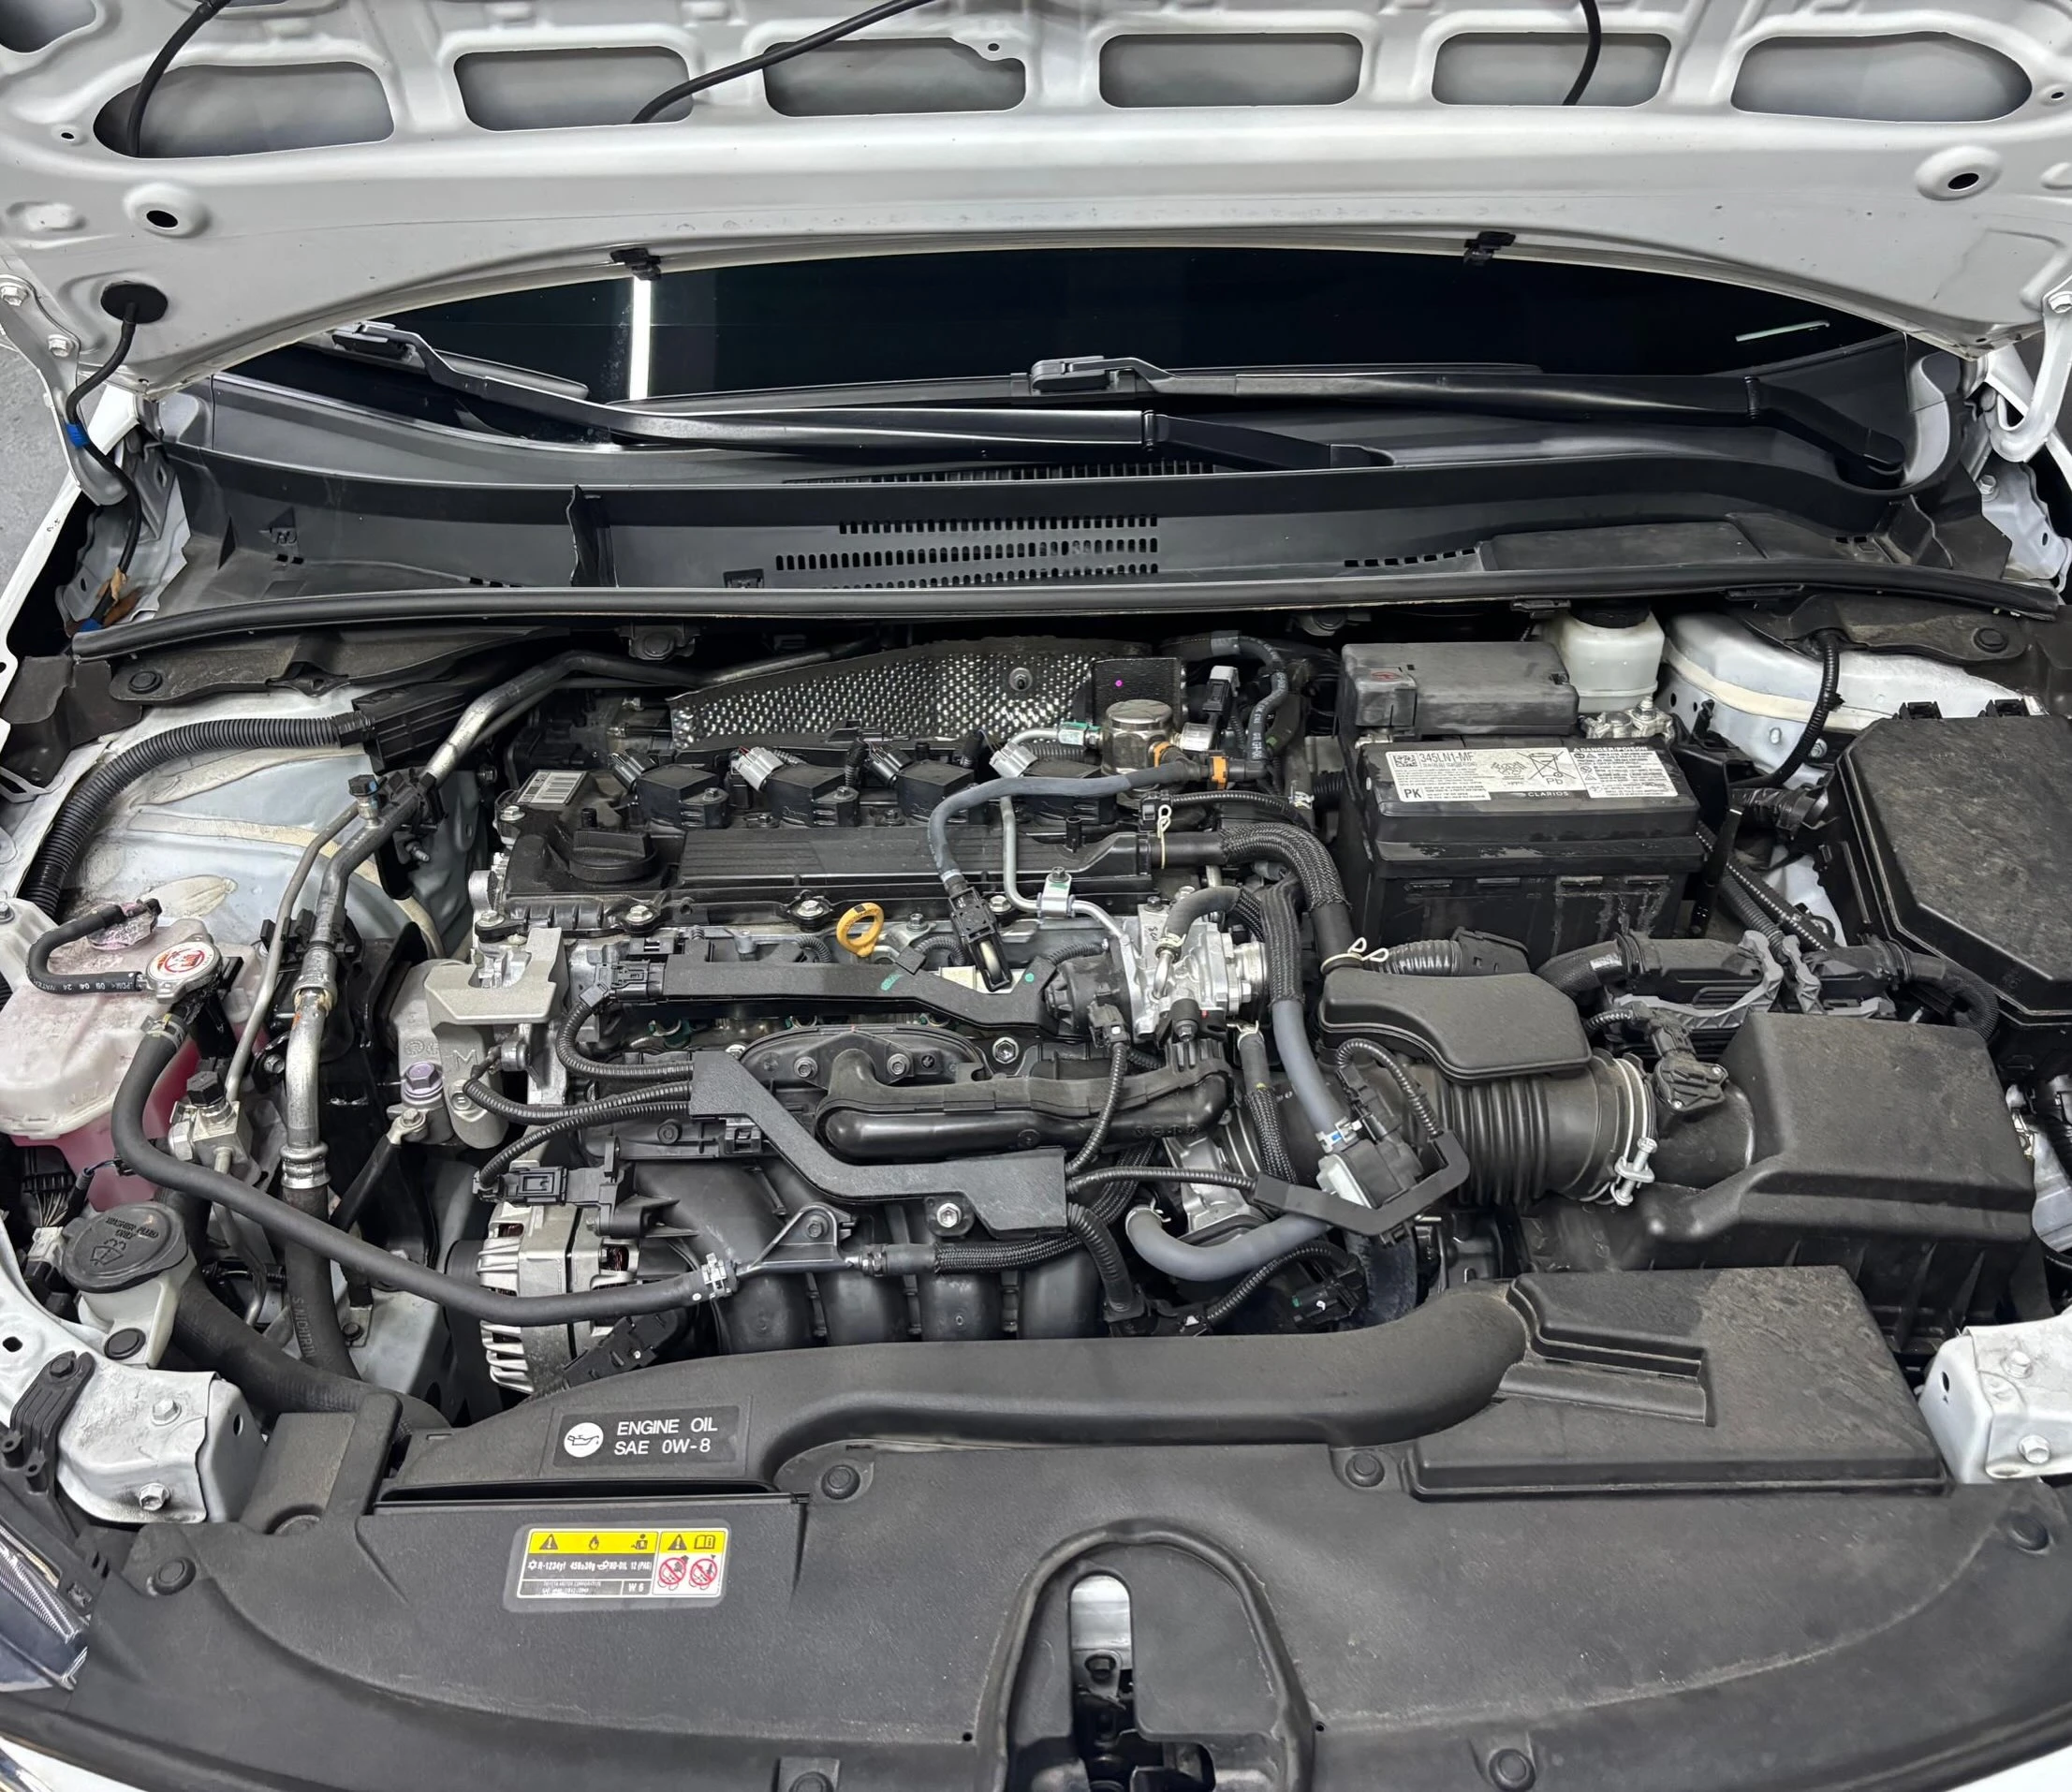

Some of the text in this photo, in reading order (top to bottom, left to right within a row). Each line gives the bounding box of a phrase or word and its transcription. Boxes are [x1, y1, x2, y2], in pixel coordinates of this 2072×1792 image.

[1419, 752, 1475, 763] 345LN1-MF
[1546, 777, 1564, 786] Pb
[1404, 788, 1422, 799] PK
[617, 1417, 718, 1435] ENGINE OIL
[614, 1437, 711, 1456] SAE 0W-8
